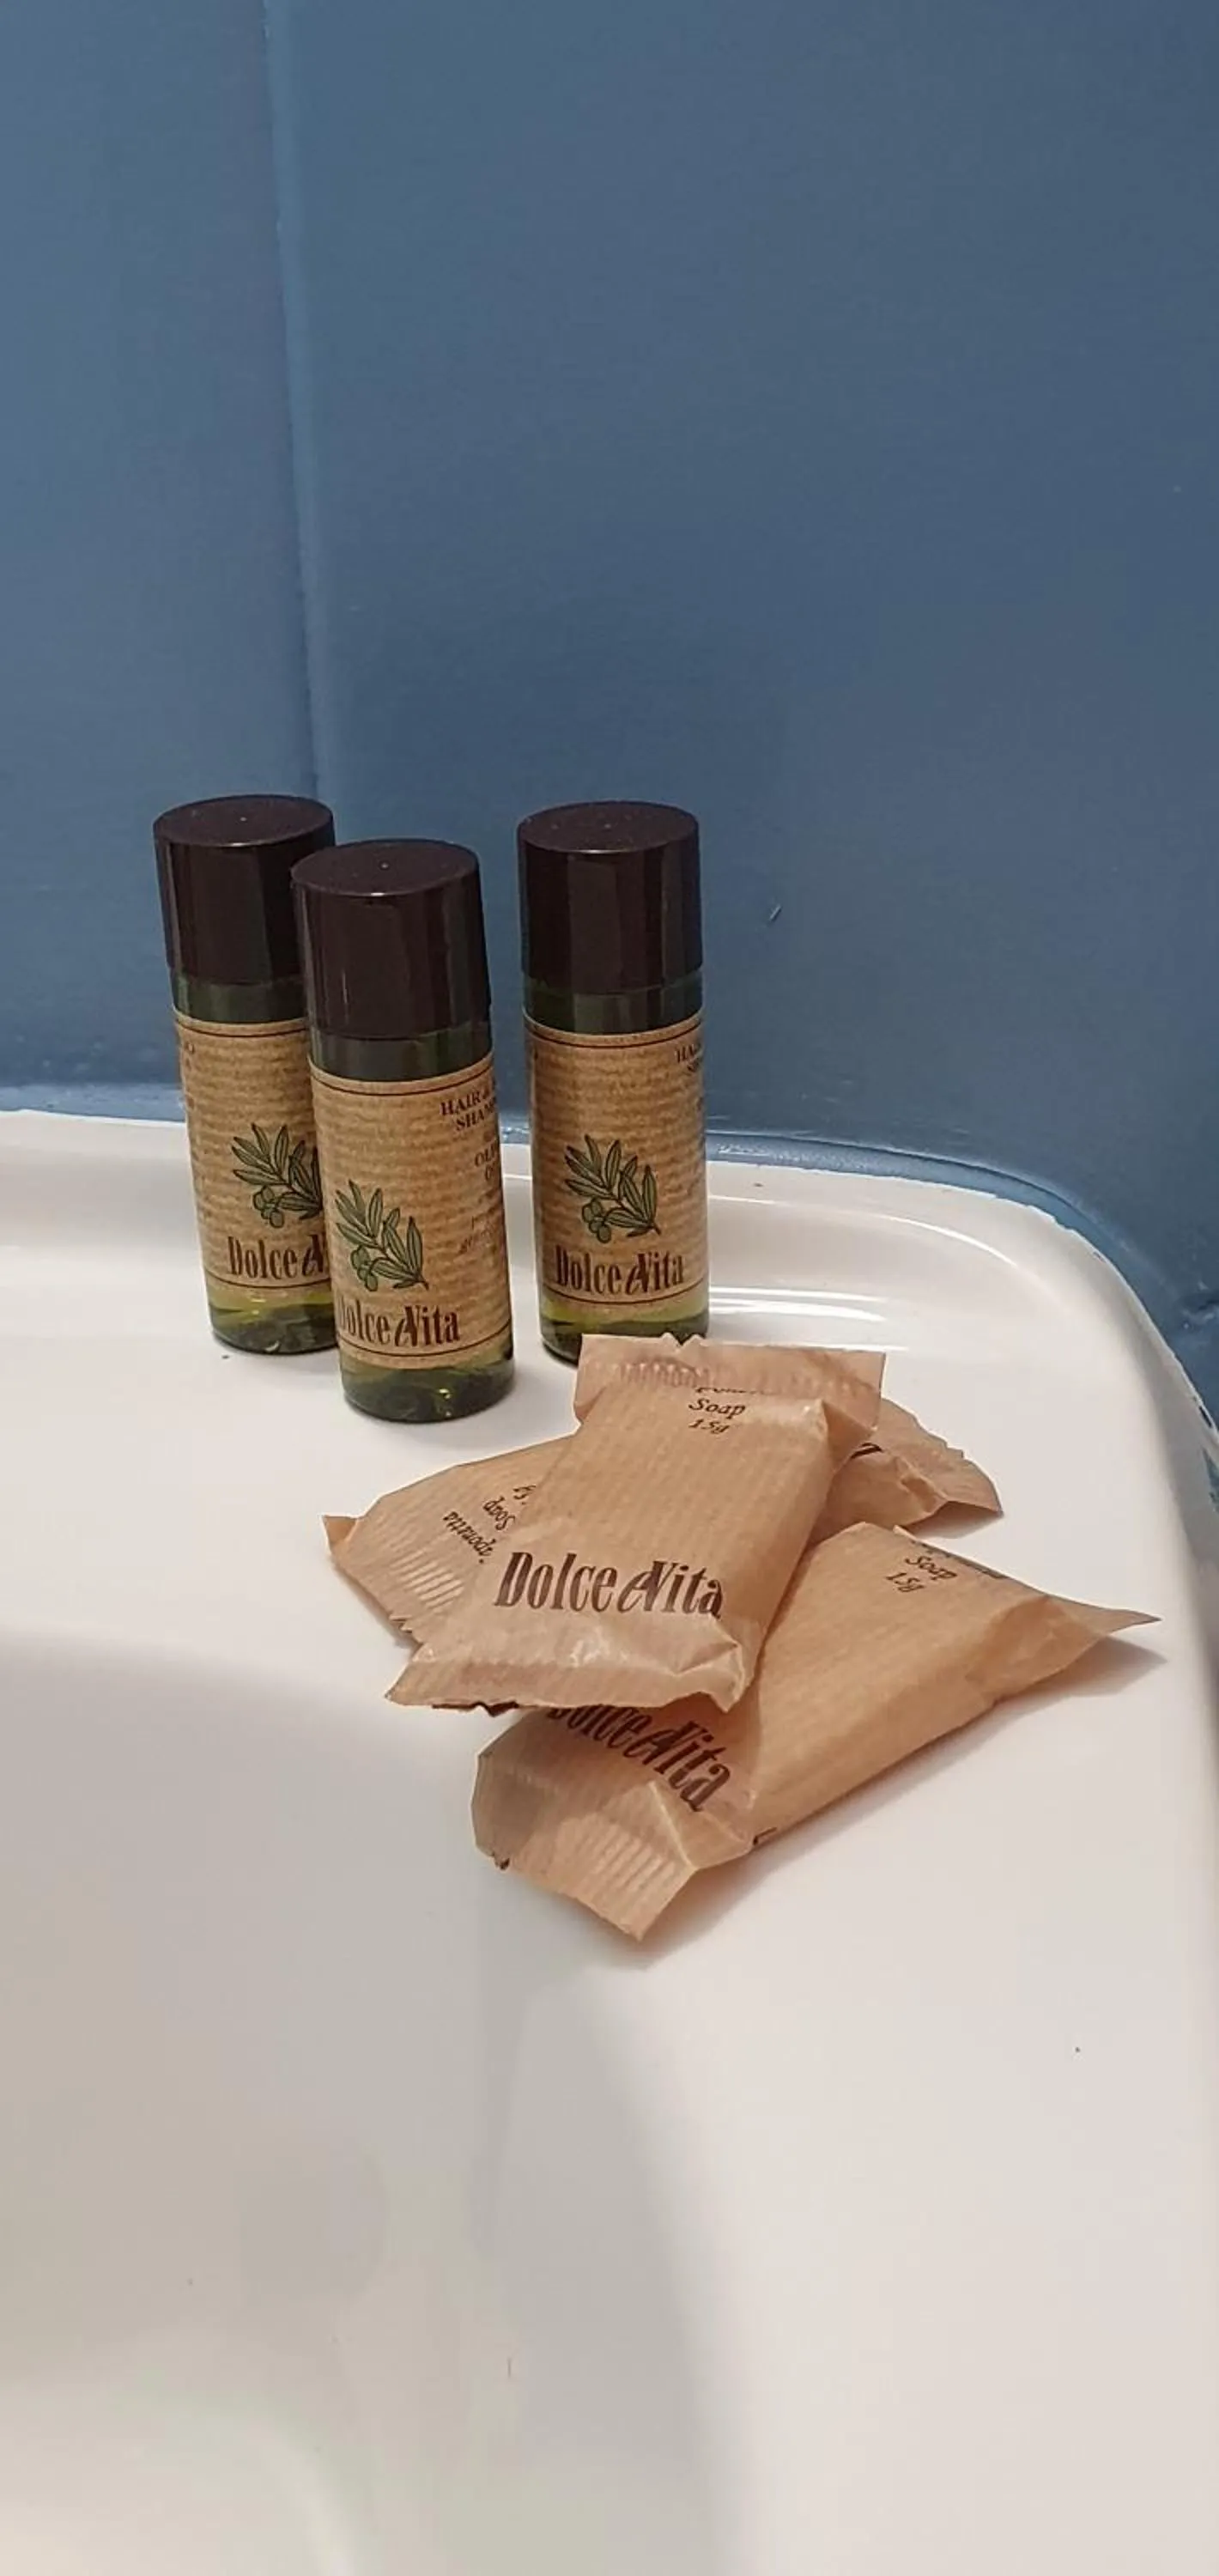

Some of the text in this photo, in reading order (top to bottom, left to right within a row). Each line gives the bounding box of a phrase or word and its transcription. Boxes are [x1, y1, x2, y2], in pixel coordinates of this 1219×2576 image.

[440, 1091, 481, 1116] HAIR
[227, 1236, 298, 1279] Dolce
[555, 1245, 622, 1295] Dolce
[688, 1398, 746, 1419] Soap
[688, 1419, 730, 1435] 15g
[482, 1496, 516, 1531] Soap
[443, 1511, 497, 1563] aponetta
[494, 1552, 618, 1613] Dolce
[885, 1571, 925, 1593] 15g
[904, 1555, 958, 1582] Soap
[546, 1704, 652, 1749] olce
